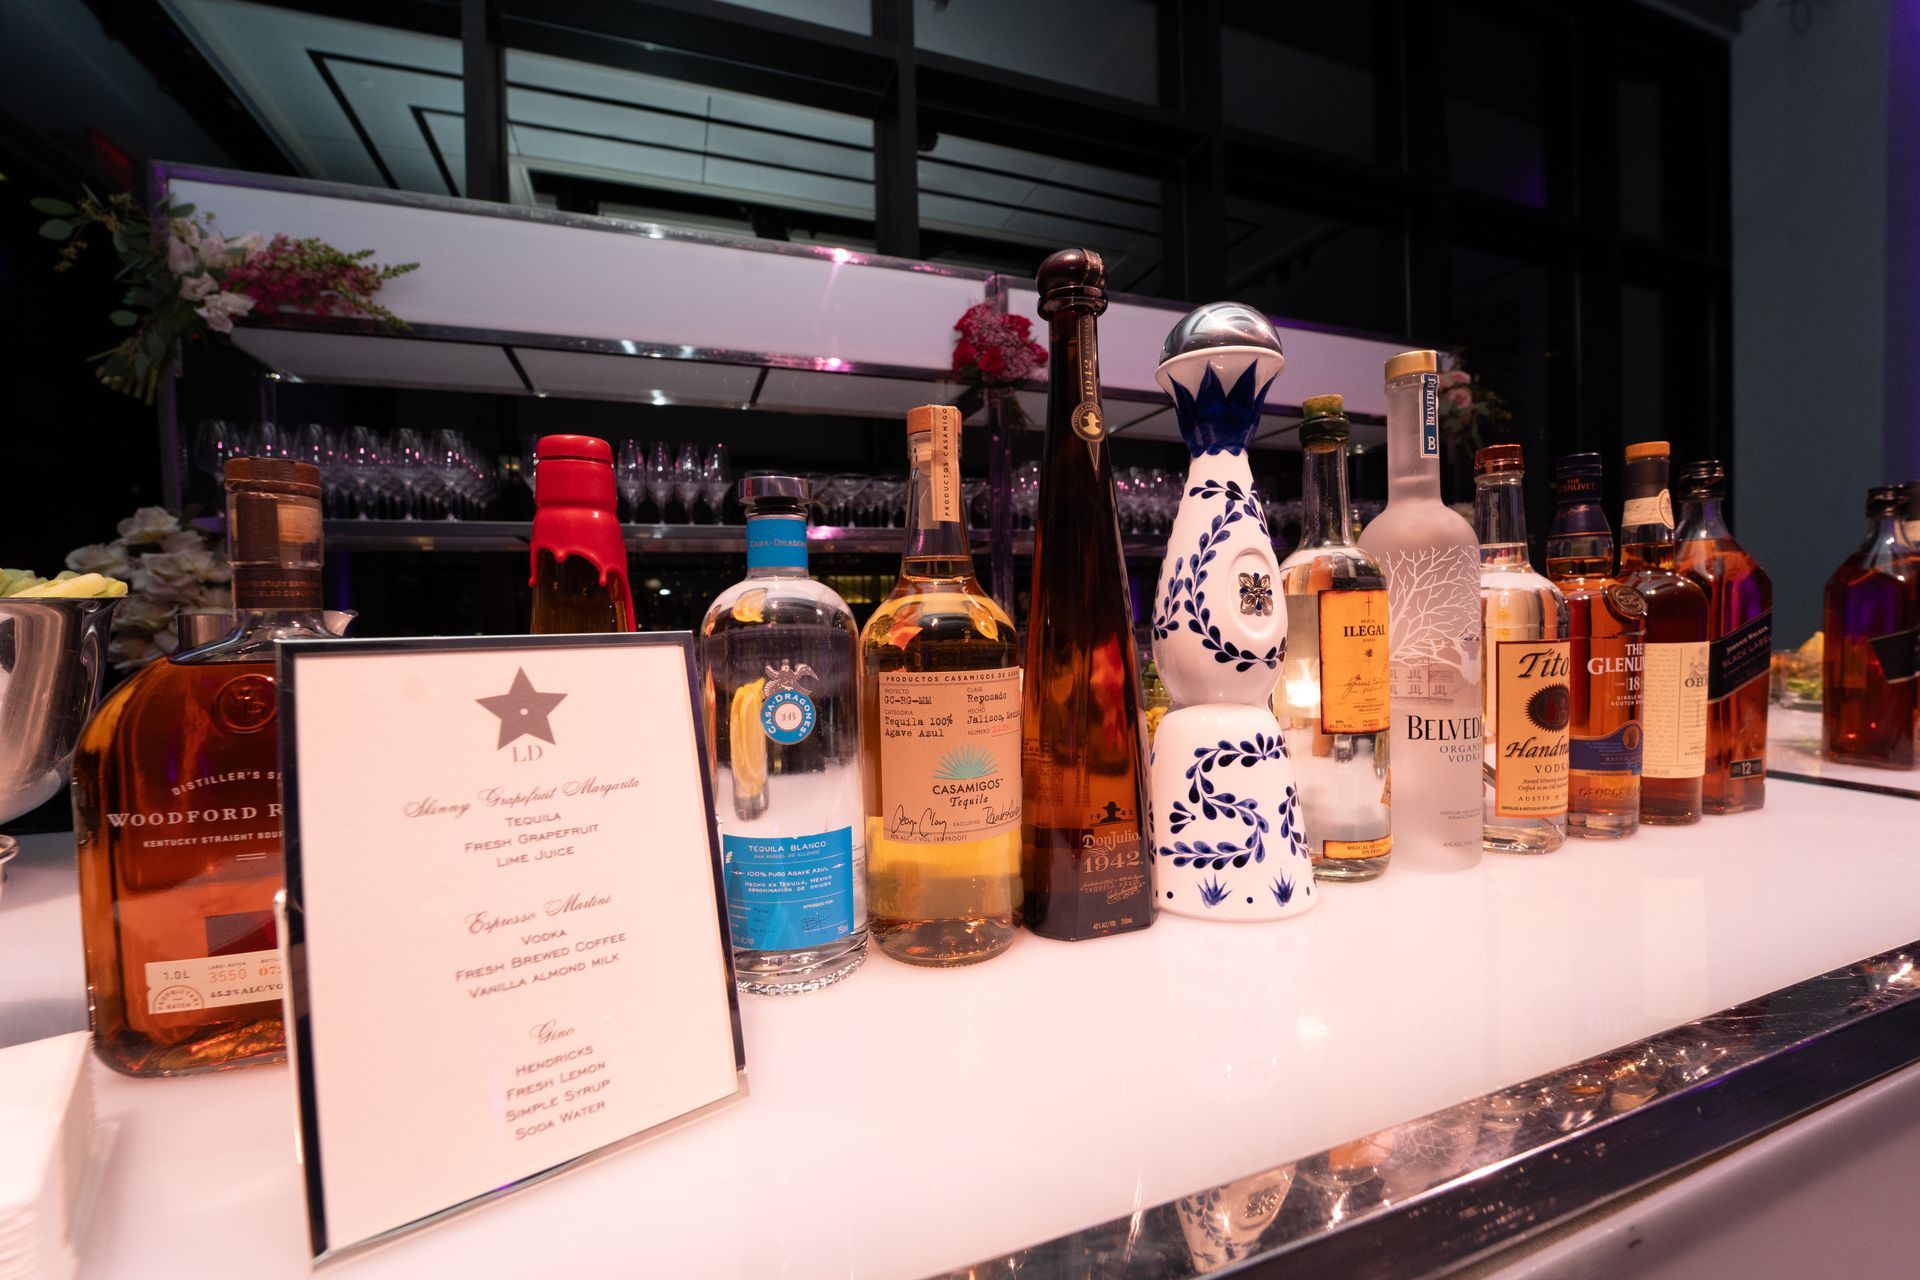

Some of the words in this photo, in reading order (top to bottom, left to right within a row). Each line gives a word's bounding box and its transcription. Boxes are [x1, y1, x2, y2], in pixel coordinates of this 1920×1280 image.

[1084, 359, 1093, 396] 1942
[1344, 624, 1386, 638] ILEGAL
[1625, 643, 1643, 656] THE
[944, 673, 995, 682] CASAMIGOS
[1628, 676, 1641, 691] 18
[884, 695, 932, 705] GC-RG-MM
[967, 692, 1007, 704] Reposado
[774, 693, 812, 734] DRAGONES
[884, 716, 924, 727] Tequila
[930, 713, 953, 727] 100%
[967, 715, 1004, 725] Jalisco,
[884, 728, 912, 738] Agave
[918, 729, 944, 738] Azul
[512, 744, 543, 763] LD
[1741, 762, 1752, 776] 12
[171, 771, 260, 796] DISTILLER'S
[402, 797, 471, 819] Skinny
[478, 786, 557, 808] Grapefruit
[561, 776, 640, 798] Margarita
[950, 794, 989, 810] Tequila
[106, 807, 257, 827] WOODFORD
[505, 813, 562, 828] TEQUILA
[143, 837, 198, 848] KENTUCKY
[201, 833, 253, 844] STRAIGHT
[464, 838, 512, 853] FRESH
[518, 824, 599, 845] GRAPEFRUIT
[748, 845, 785, 853] TEQUILA
[790, 840, 827, 852] BLANCO
[496, 853, 529, 868] LIME
[534, 846, 575, 861] JUICE
[1083, 850, 1140, 873] 1942
[787, 869, 811, 877] AGAVE
[812, 866, 830, 874] AZUL
[465, 911, 537, 934] Espresso
[544, 892, 613, 916] Martini
[520, 929, 567, 946] VODKA
[455, 963, 505, 982] FRESH
[511, 947, 570, 969] BREWED
[575, 933, 627, 952] COFFEE
[208, 969, 247, 983] 3550
[468, 978, 527, 999] VANILLA
[532, 962, 586, 983] ALMOND
[591, 953, 620, 968] MILK
[515, 1045, 594, 1077] HENDRICKS
[506, 1076, 554, 1101] FRESH
[560, 1061, 606, 1084] LEMON
[505, 1096, 558, 1123] SIMPLE
[564, 1079, 611, 1102] SYRUP
[515, 1120, 555, 1141] SODA
[559, 1100, 606, 1123] WATER
